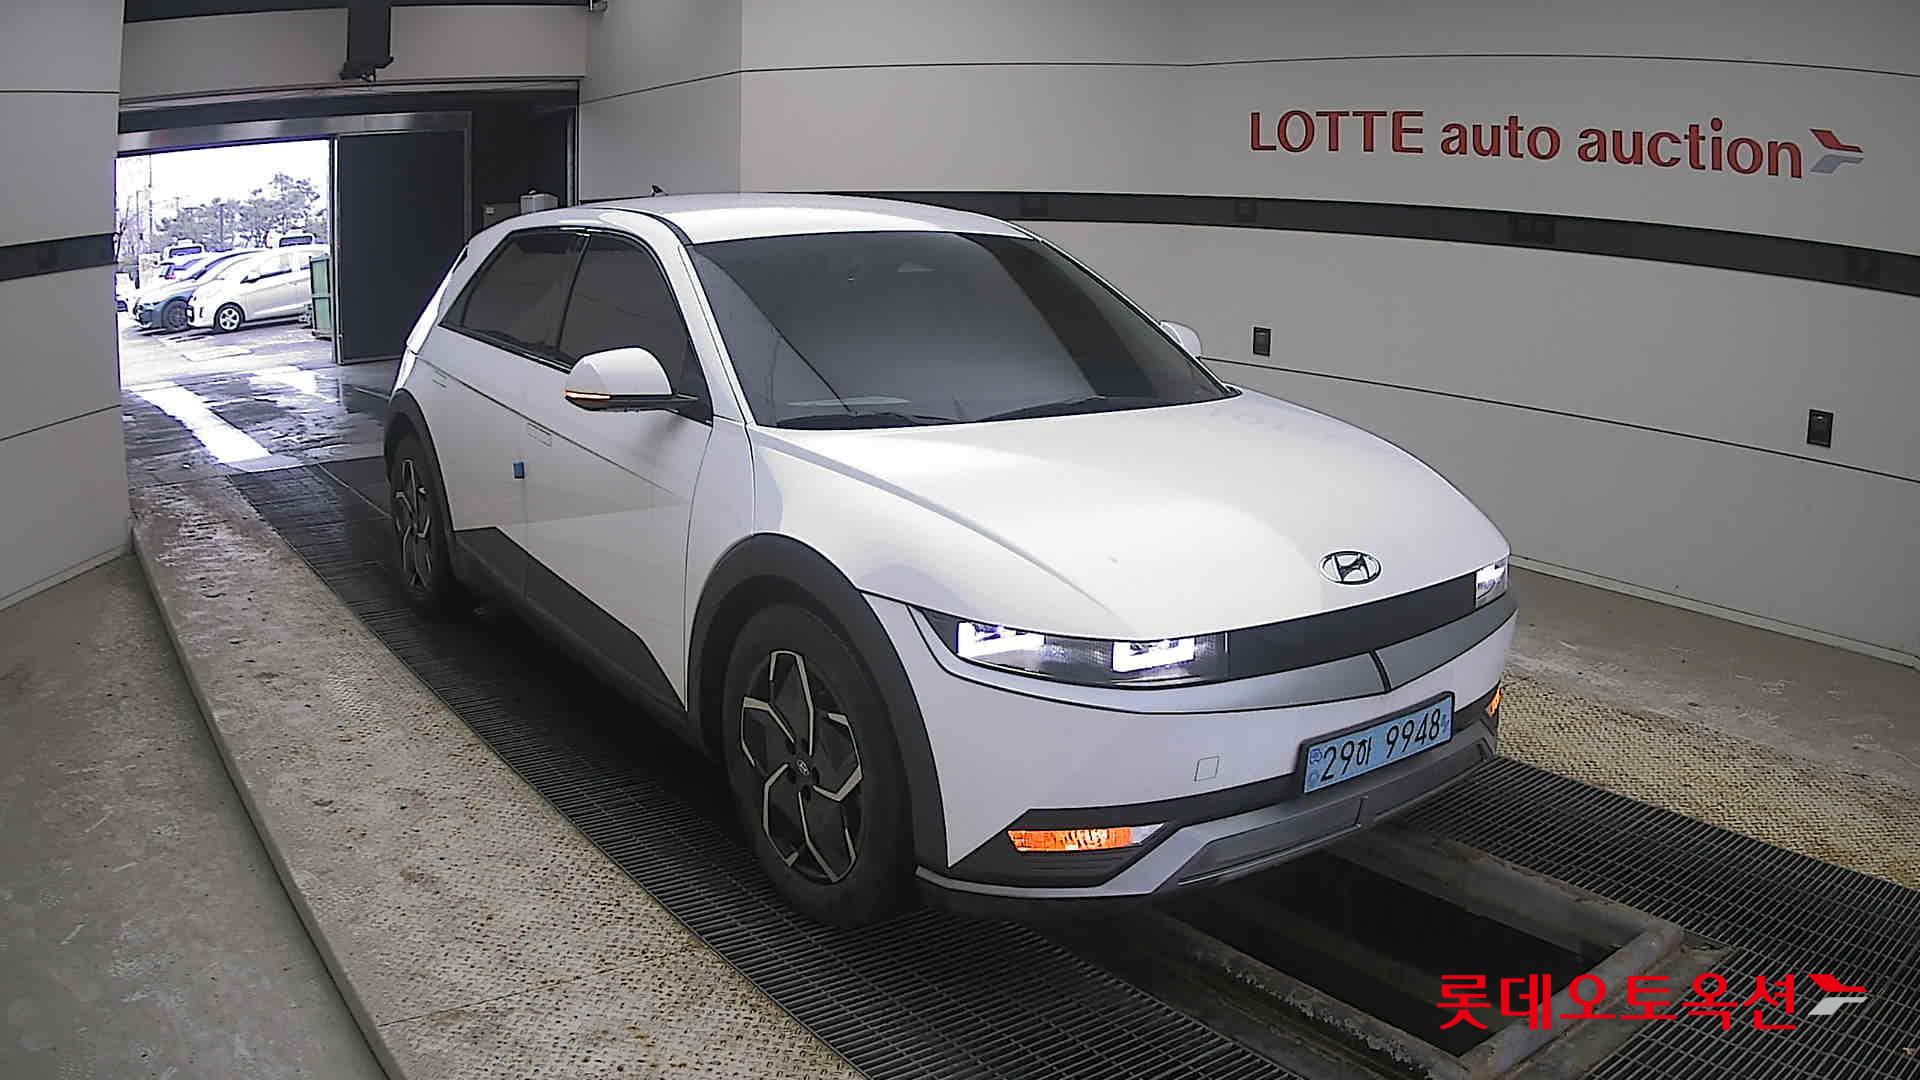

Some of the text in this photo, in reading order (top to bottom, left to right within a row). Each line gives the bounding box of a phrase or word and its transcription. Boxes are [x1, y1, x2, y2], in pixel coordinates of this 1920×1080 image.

[1250, 110, 1803, 179] LOTTE auto auction
[1319, 708, 1441, 782] 29하 9948
